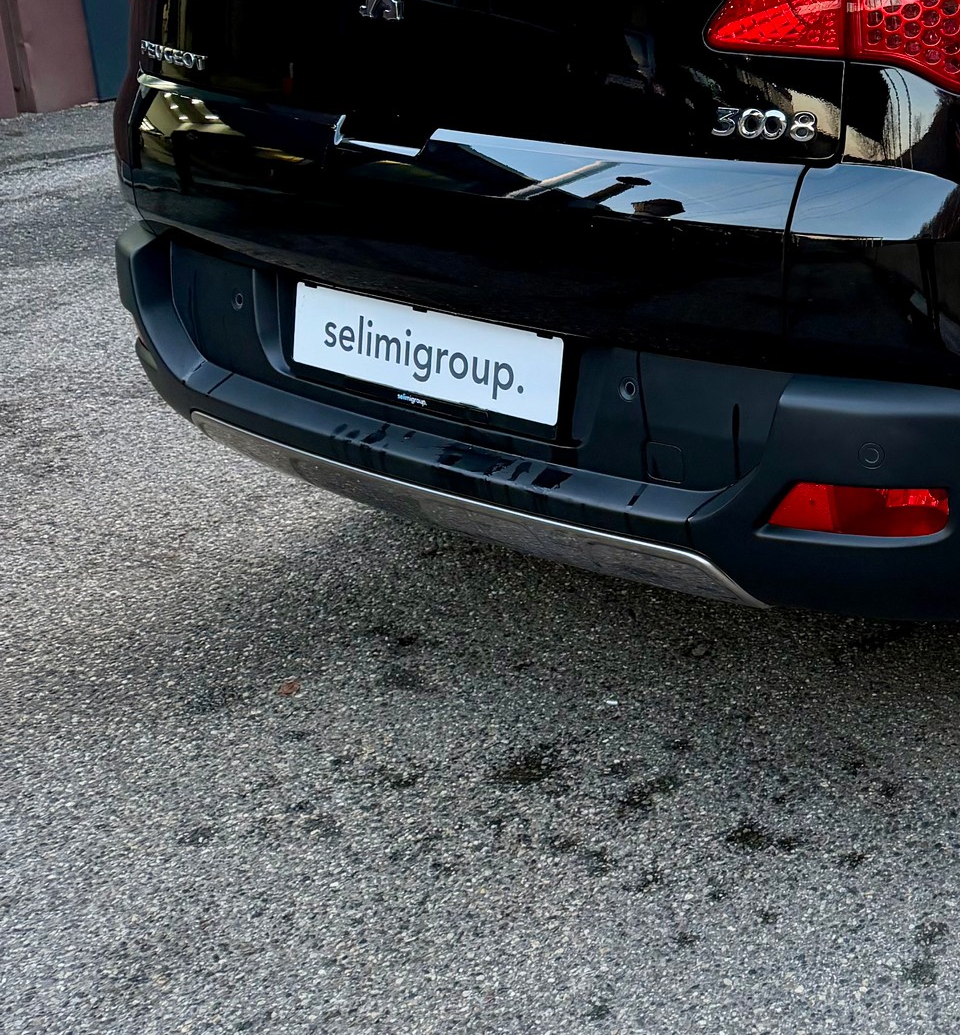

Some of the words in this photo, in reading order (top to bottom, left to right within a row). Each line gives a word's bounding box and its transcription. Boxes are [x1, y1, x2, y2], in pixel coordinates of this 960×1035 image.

[141, 39, 208, 70] PEUGEOT
[711, 106, 817, 142] 3008
[323, 315, 524, 400] selimigroup.
